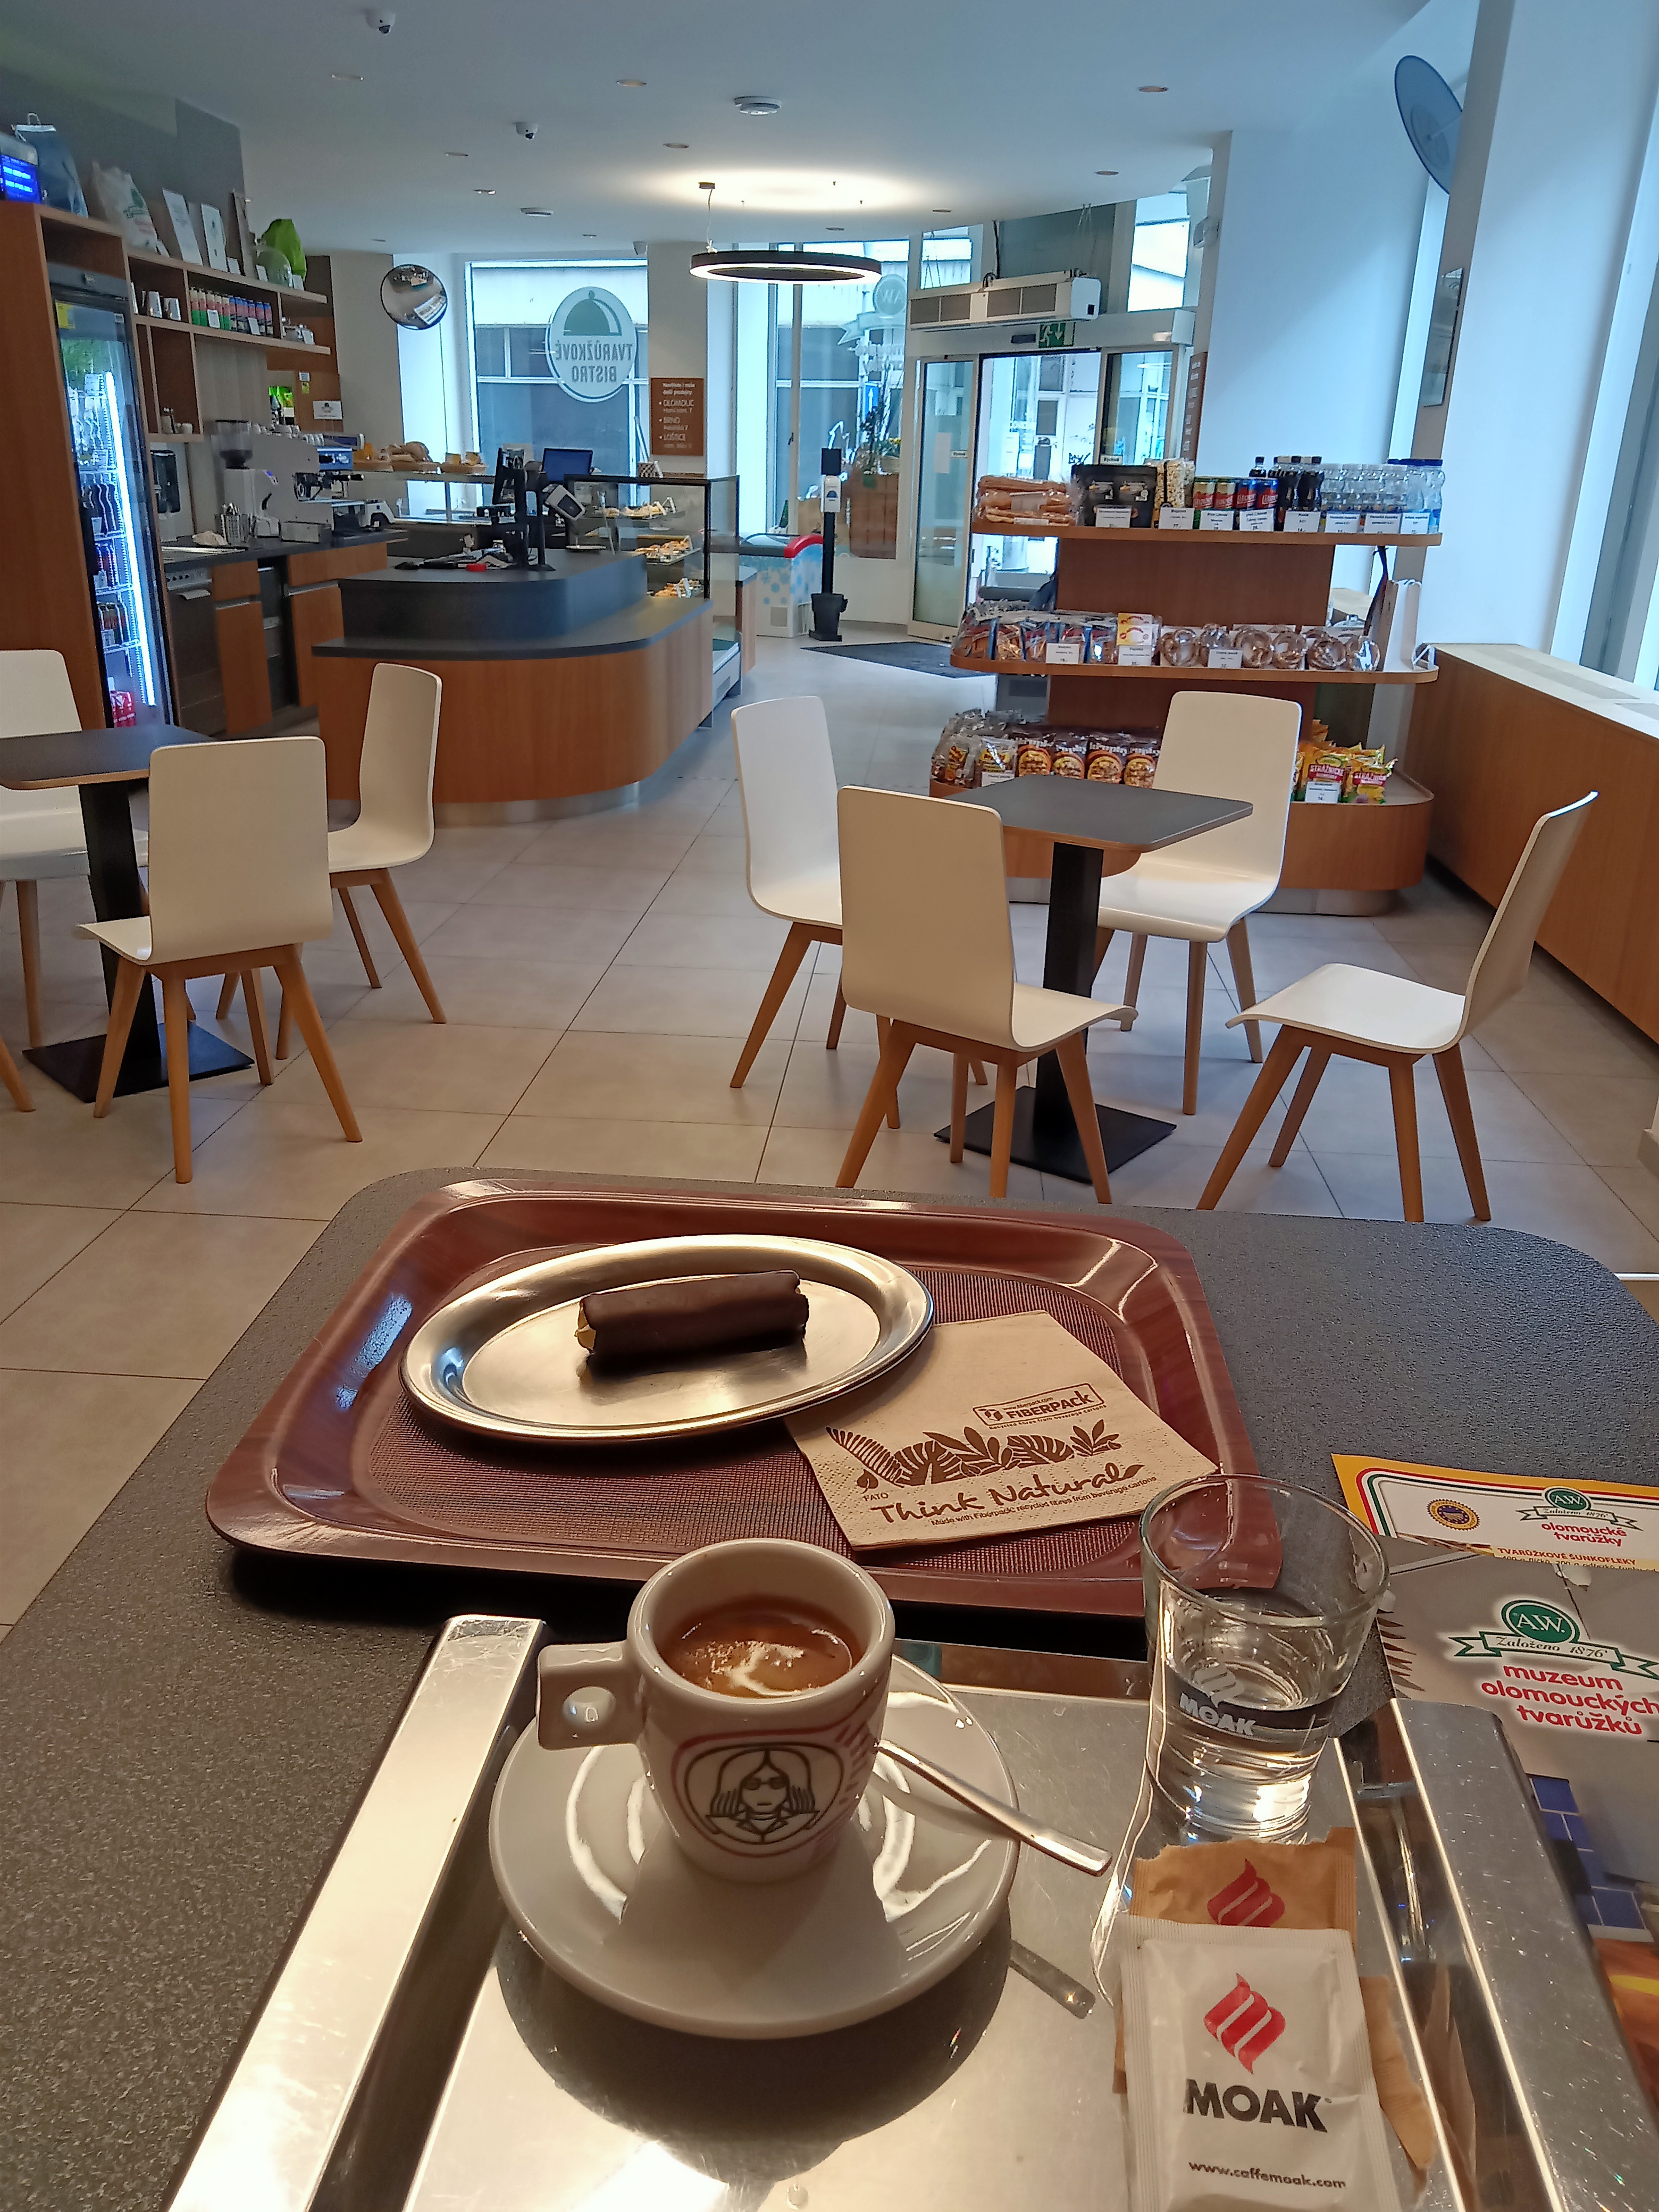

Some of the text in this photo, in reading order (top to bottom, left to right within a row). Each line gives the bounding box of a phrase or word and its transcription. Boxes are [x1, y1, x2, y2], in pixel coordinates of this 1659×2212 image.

[862, 1493, 889, 1502] FATO
[870, 1462, 1144, 1523] Think Natural
[955, 1514, 974, 1522] with
[1016, 1501, 1048, 1511] recycled
[1050, 1497, 1072, 1506] fibres
[1092, 1485, 1128, 1498] beverage
[1128, 1476, 1157, 1488] cartons
[1541, 1522, 1627, 1537] olomoucké
[1554, 1532, 1622, 1547] tvarůžky
[1497, 1548, 1636, 1565] TVARŮŽKOVÉ ŠUNKOFLEKY
[1516, 1613, 1565, 1633] A.W.
[1496, 1636, 1560, 1652] Založeno
[1503, 1665, 1623, 1690] muzeum
[1481, 1680, 1659, 1716] olomouckých
[1179, 1692, 1256, 1736] MOAK
[1516, 1705, 1643, 1735] tvarůžků
[1186, 2078, 1328, 2133] MOAK
[1188, 2160, 1347, 2190] www.caffemoak.com
